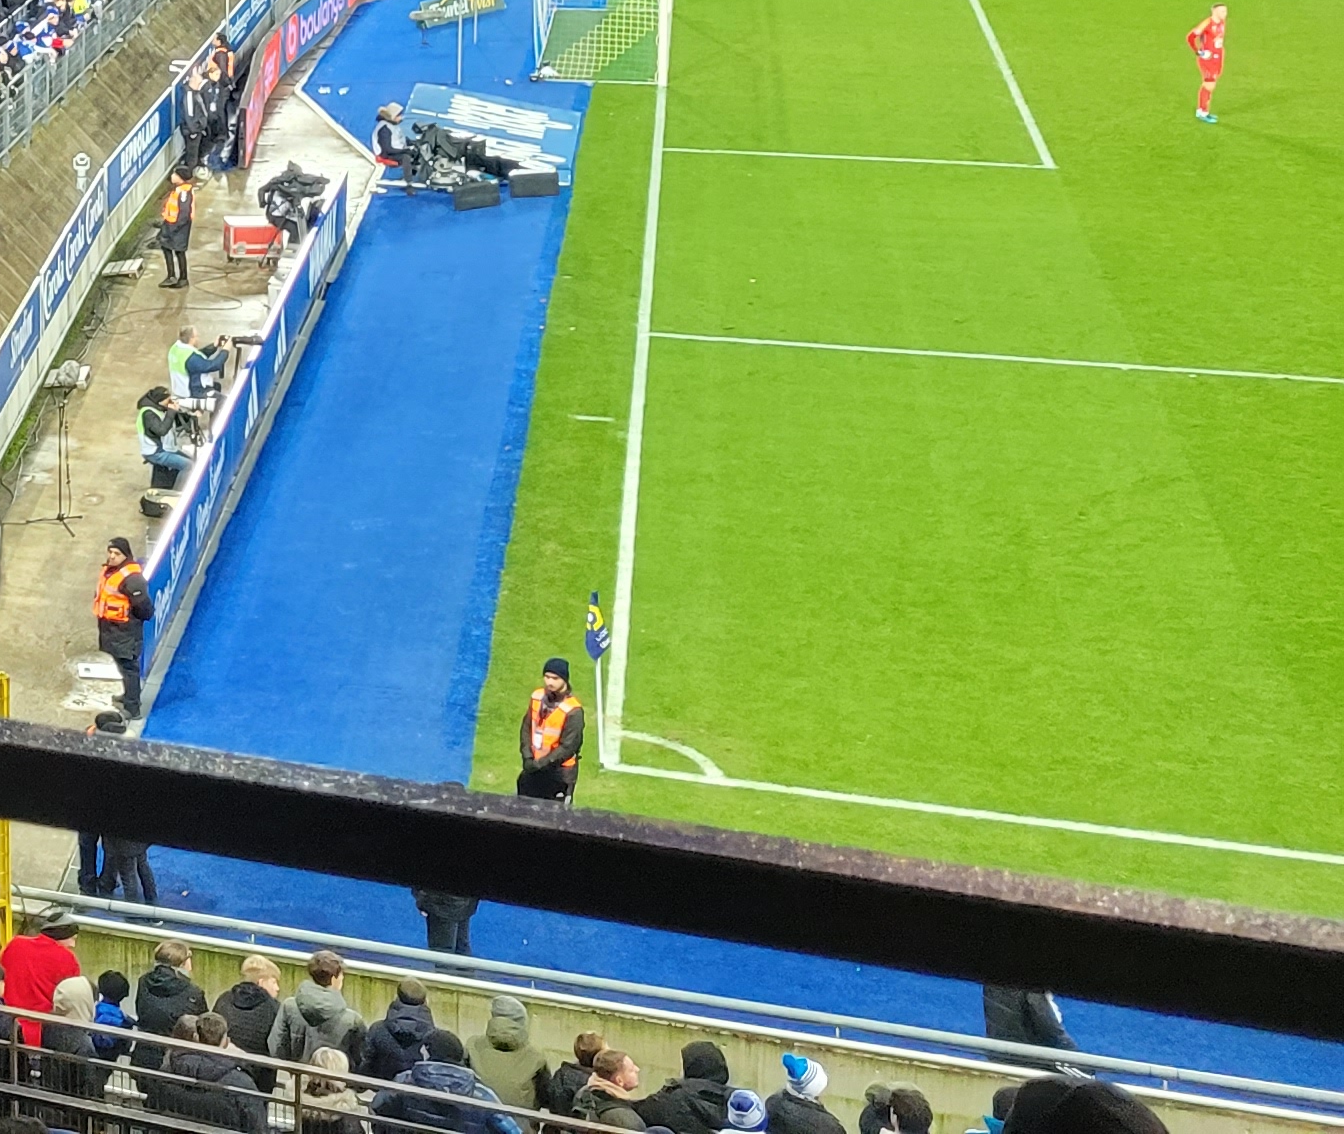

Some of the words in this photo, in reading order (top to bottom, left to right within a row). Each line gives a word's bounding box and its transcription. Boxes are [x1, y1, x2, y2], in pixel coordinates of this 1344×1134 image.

[120, 110, 160, 179] REPROLAND
[85, 185, 104, 245] Carola
[65, 218, 85, 282] Carola
[43, 257, 65, 321] Carola
